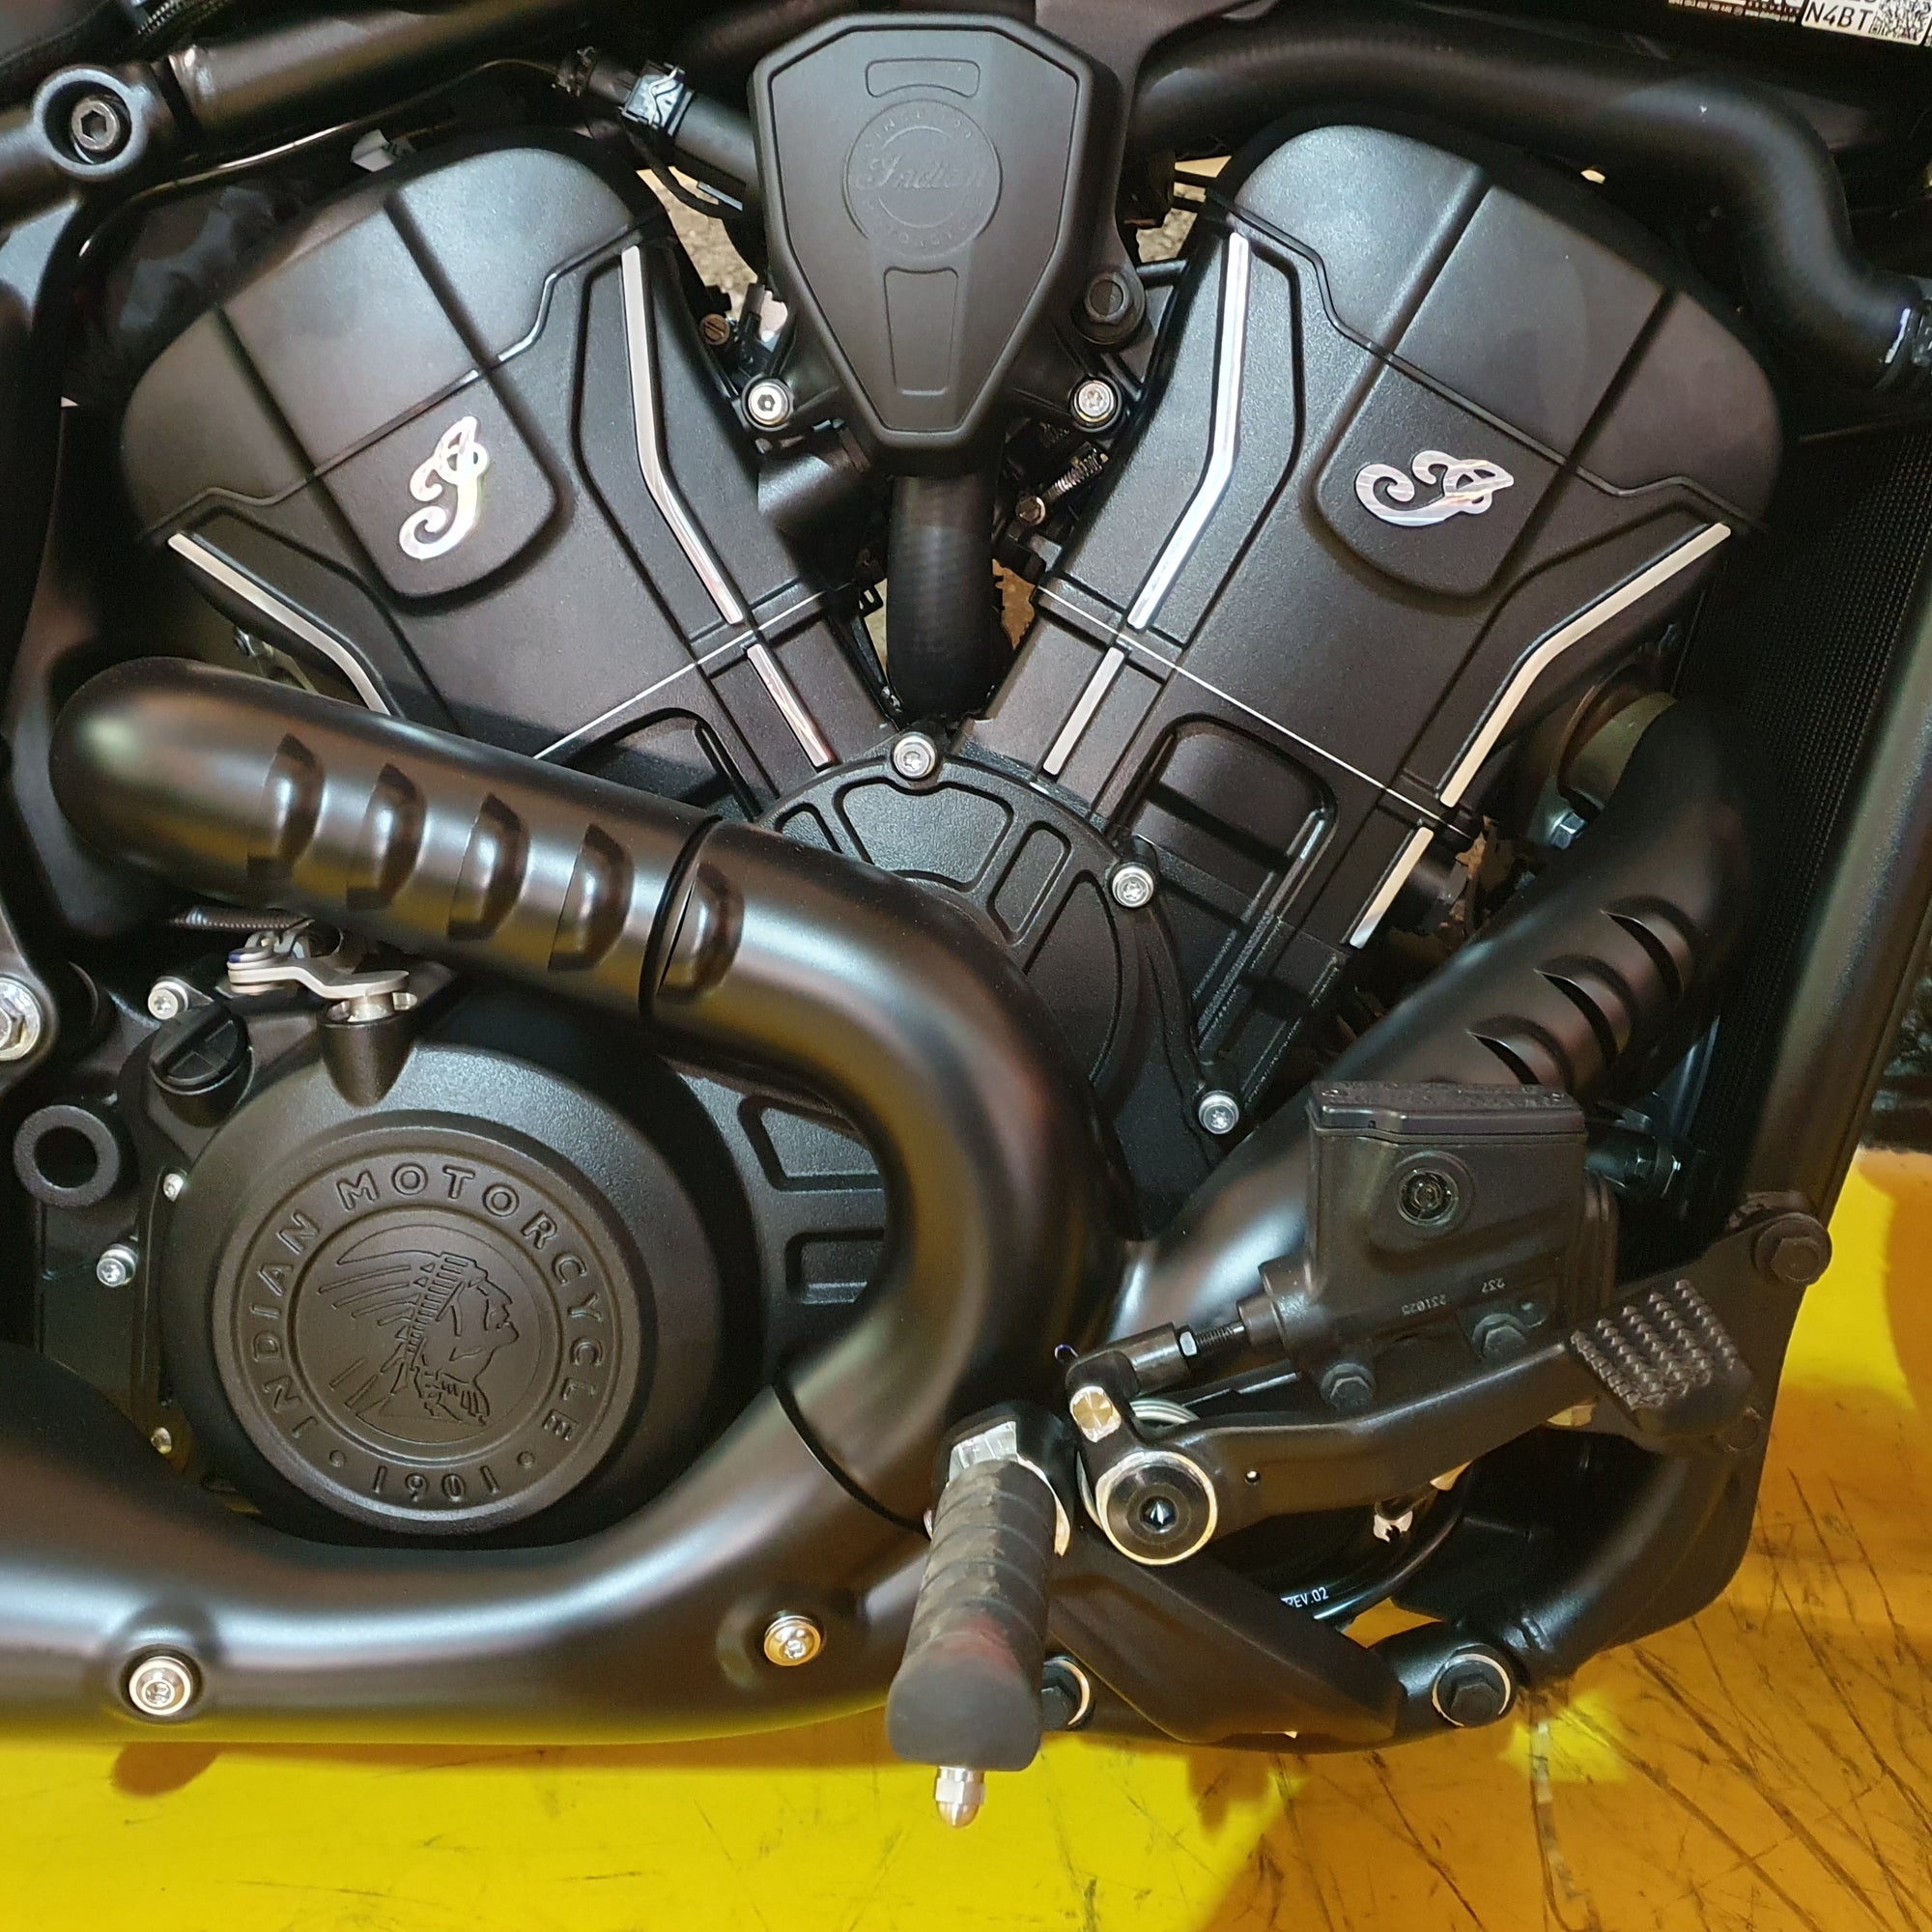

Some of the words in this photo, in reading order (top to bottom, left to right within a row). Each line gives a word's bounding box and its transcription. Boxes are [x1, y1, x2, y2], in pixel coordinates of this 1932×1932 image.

[1804, 1, 1874, 31] N4BT
[249, 1210, 321, 1439] INDIAN
[335, 1162, 605, 1442] MOTORCYCLE
[373, 1464, 500, 1502] 1901
